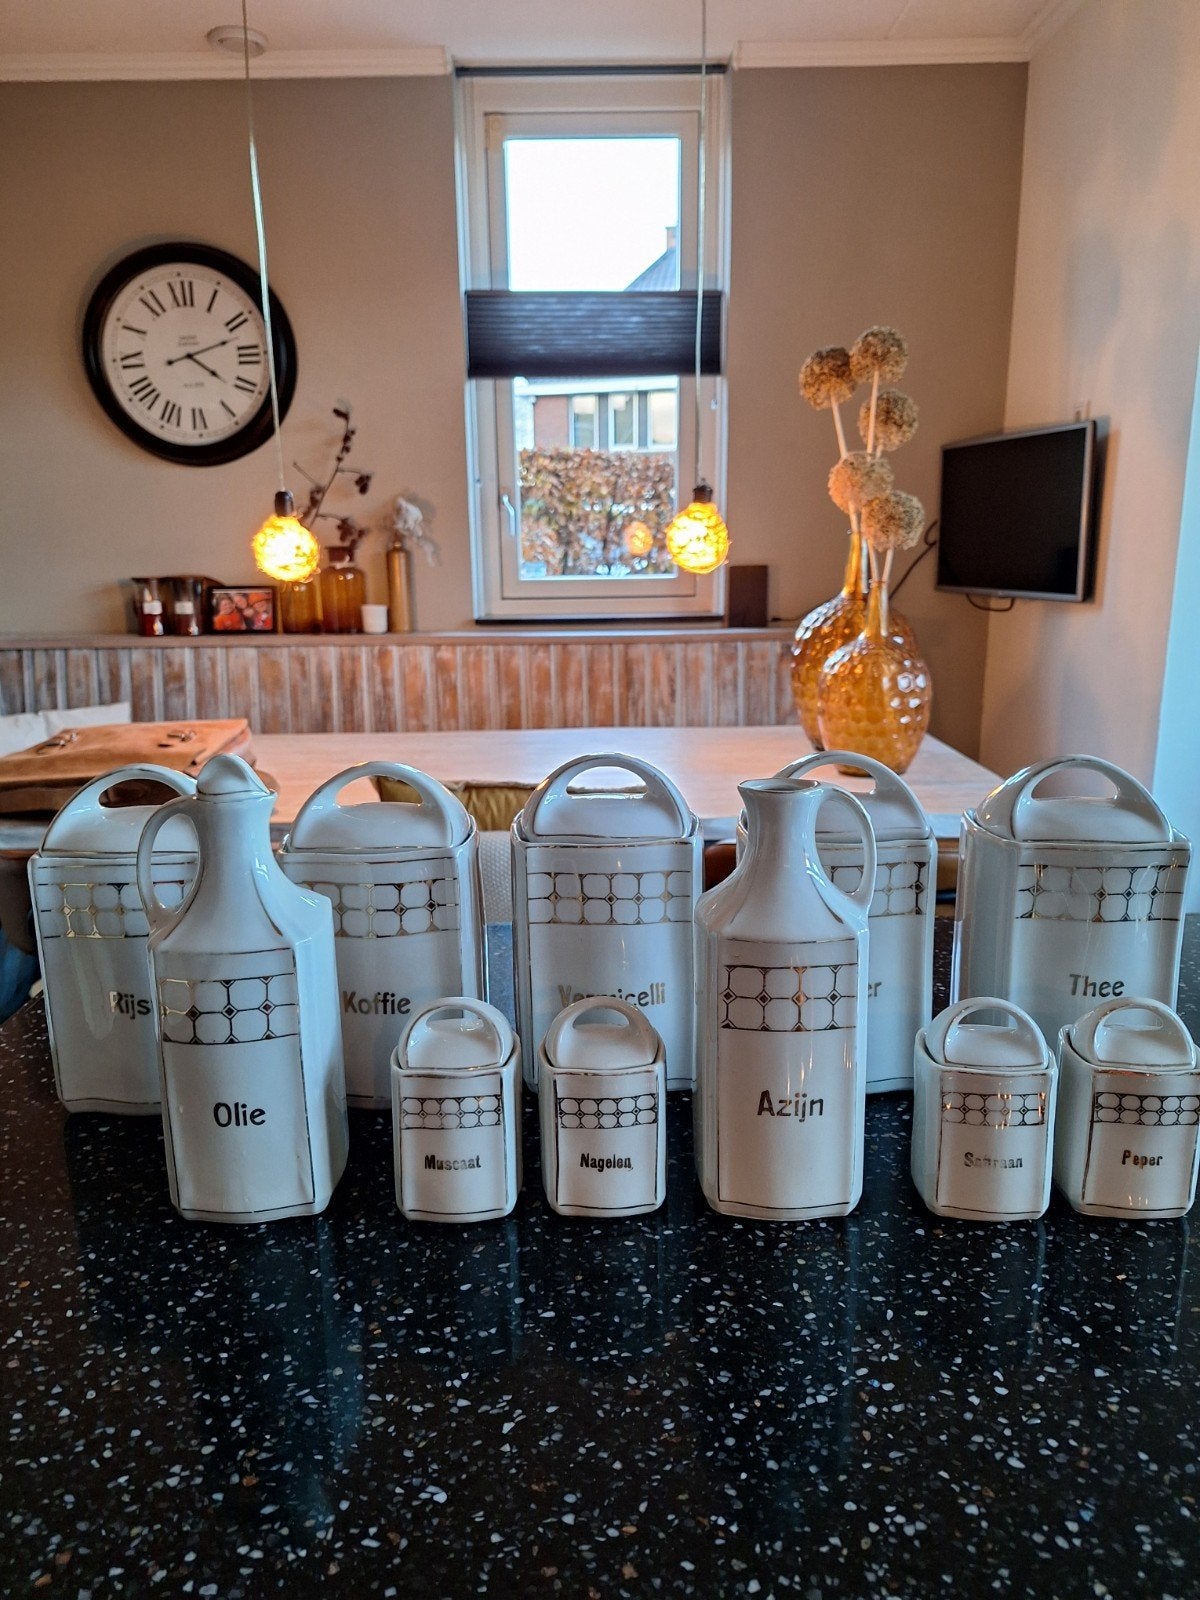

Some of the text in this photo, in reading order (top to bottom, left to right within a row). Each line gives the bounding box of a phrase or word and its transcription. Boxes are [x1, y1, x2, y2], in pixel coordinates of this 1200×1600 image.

[1069, 974, 1125, 998] Thee
[110, 991, 152, 1020] Rijs
[343, 991, 410, 1016] Koffie
[213, 1101, 266, 1127] Olie
[757, 1089, 824, 1122] Azijn
[424, 1154, 482, 1171] Muscaat
[579, 1152, 633, 1172] Nagelen
[1121, 1149, 1163, 1170] Peper
